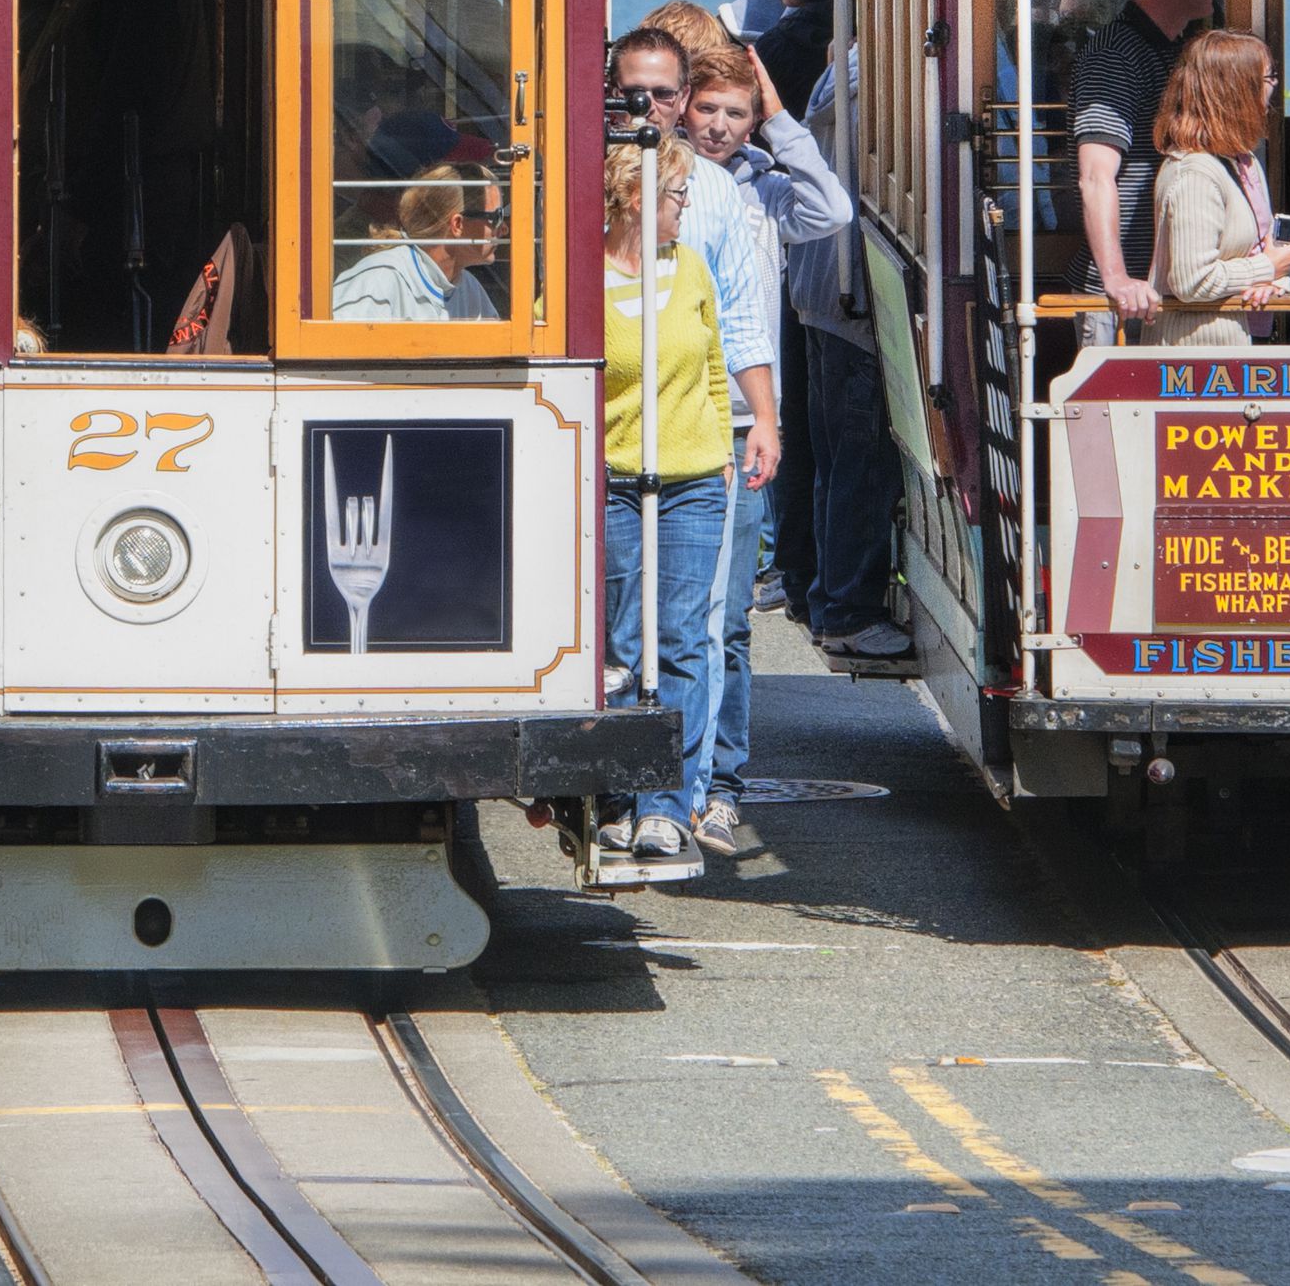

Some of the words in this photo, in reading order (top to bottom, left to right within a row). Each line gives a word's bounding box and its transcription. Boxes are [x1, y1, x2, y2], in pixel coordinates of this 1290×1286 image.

[67, 409, 215, 472] 27
[1165, 536, 1224, 565] HYDE
[1230, 537, 1260, 564] AND
[1214, 593, 1290, 614] WHARF
